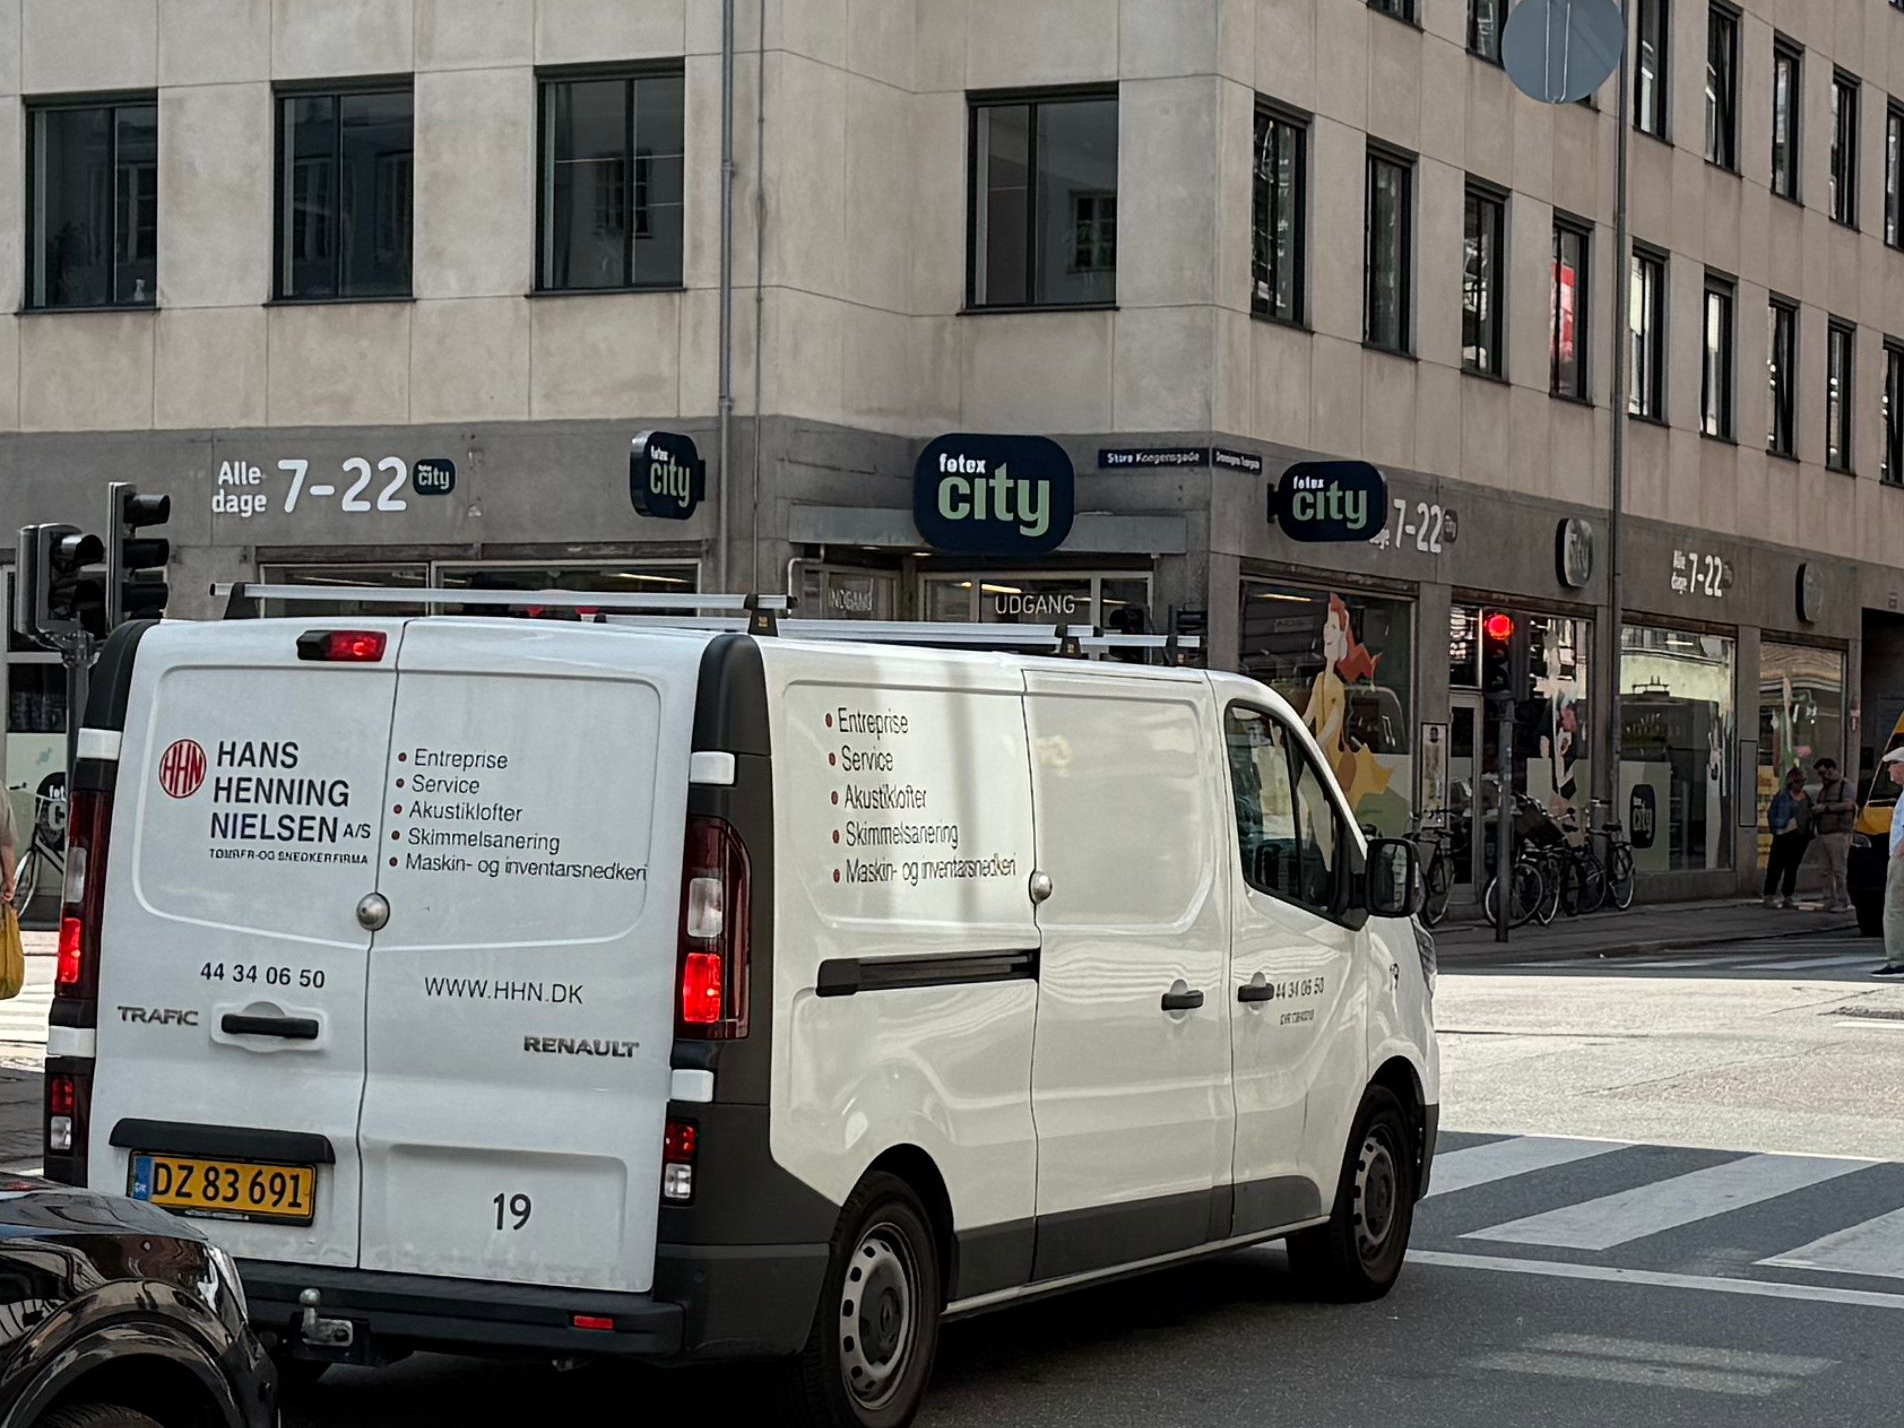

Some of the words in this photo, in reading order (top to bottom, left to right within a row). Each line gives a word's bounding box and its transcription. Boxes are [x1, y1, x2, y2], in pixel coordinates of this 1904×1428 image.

[217, 460, 262, 485] Alle
[277, 456, 407, 513] 7-22
[418, 468, 450, 490] city
[650, 454, 690, 508] city
[212, 488, 267, 517] dage
[937, 462, 1050, 537] city
[1292, 480, 1368, 529] city
[1394, 498, 1442, 554] 7-22
[996, 594, 1075, 615] UDGANG
[838, 707, 909, 740] Entreprise
[217, 740, 299, 769] HANS
[414, 748, 509, 772] Entreprise
[841, 745, 893, 772] Service
[213, 776, 349, 807] HENNING
[412, 773, 480, 795] Service
[844, 783, 927, 809] Akustiklofter
[409, 800, 523, 822] Akustiklofter
[210, 812, 338, 843] NIELSEN
[343, 823, 371, 839] A/S
[407, 827, 560, 855] Skimmelsanering
[846, 820, 959, 850] Skimmelsanering
[405, 852, 472, 873] Maskin-
[477, 859, 499, 878] og
[505, 856, 648, 881] inventarsnedkeri
[846, 857, 897, 884] Maskin-
[902, 863, 919, 887] og
[200, 962, 225, 981] 44
[232, 964, 258, 983] 34
[265, 966, 291, 986] 06
[299, 969, 325, 988] 50
[424, 976, 583, 1004] WWW.HHN.DK
[117, 1005, 199, 1026] TRAFIC
[523, 1035, 640, 1058] RENAULT
[152, 1162, 195, 1198] DZ
[202, 1166, 239, 1202] 83
[249, 1169, 302, 1208] 691
[493, 1192, 532, 1231] 19
